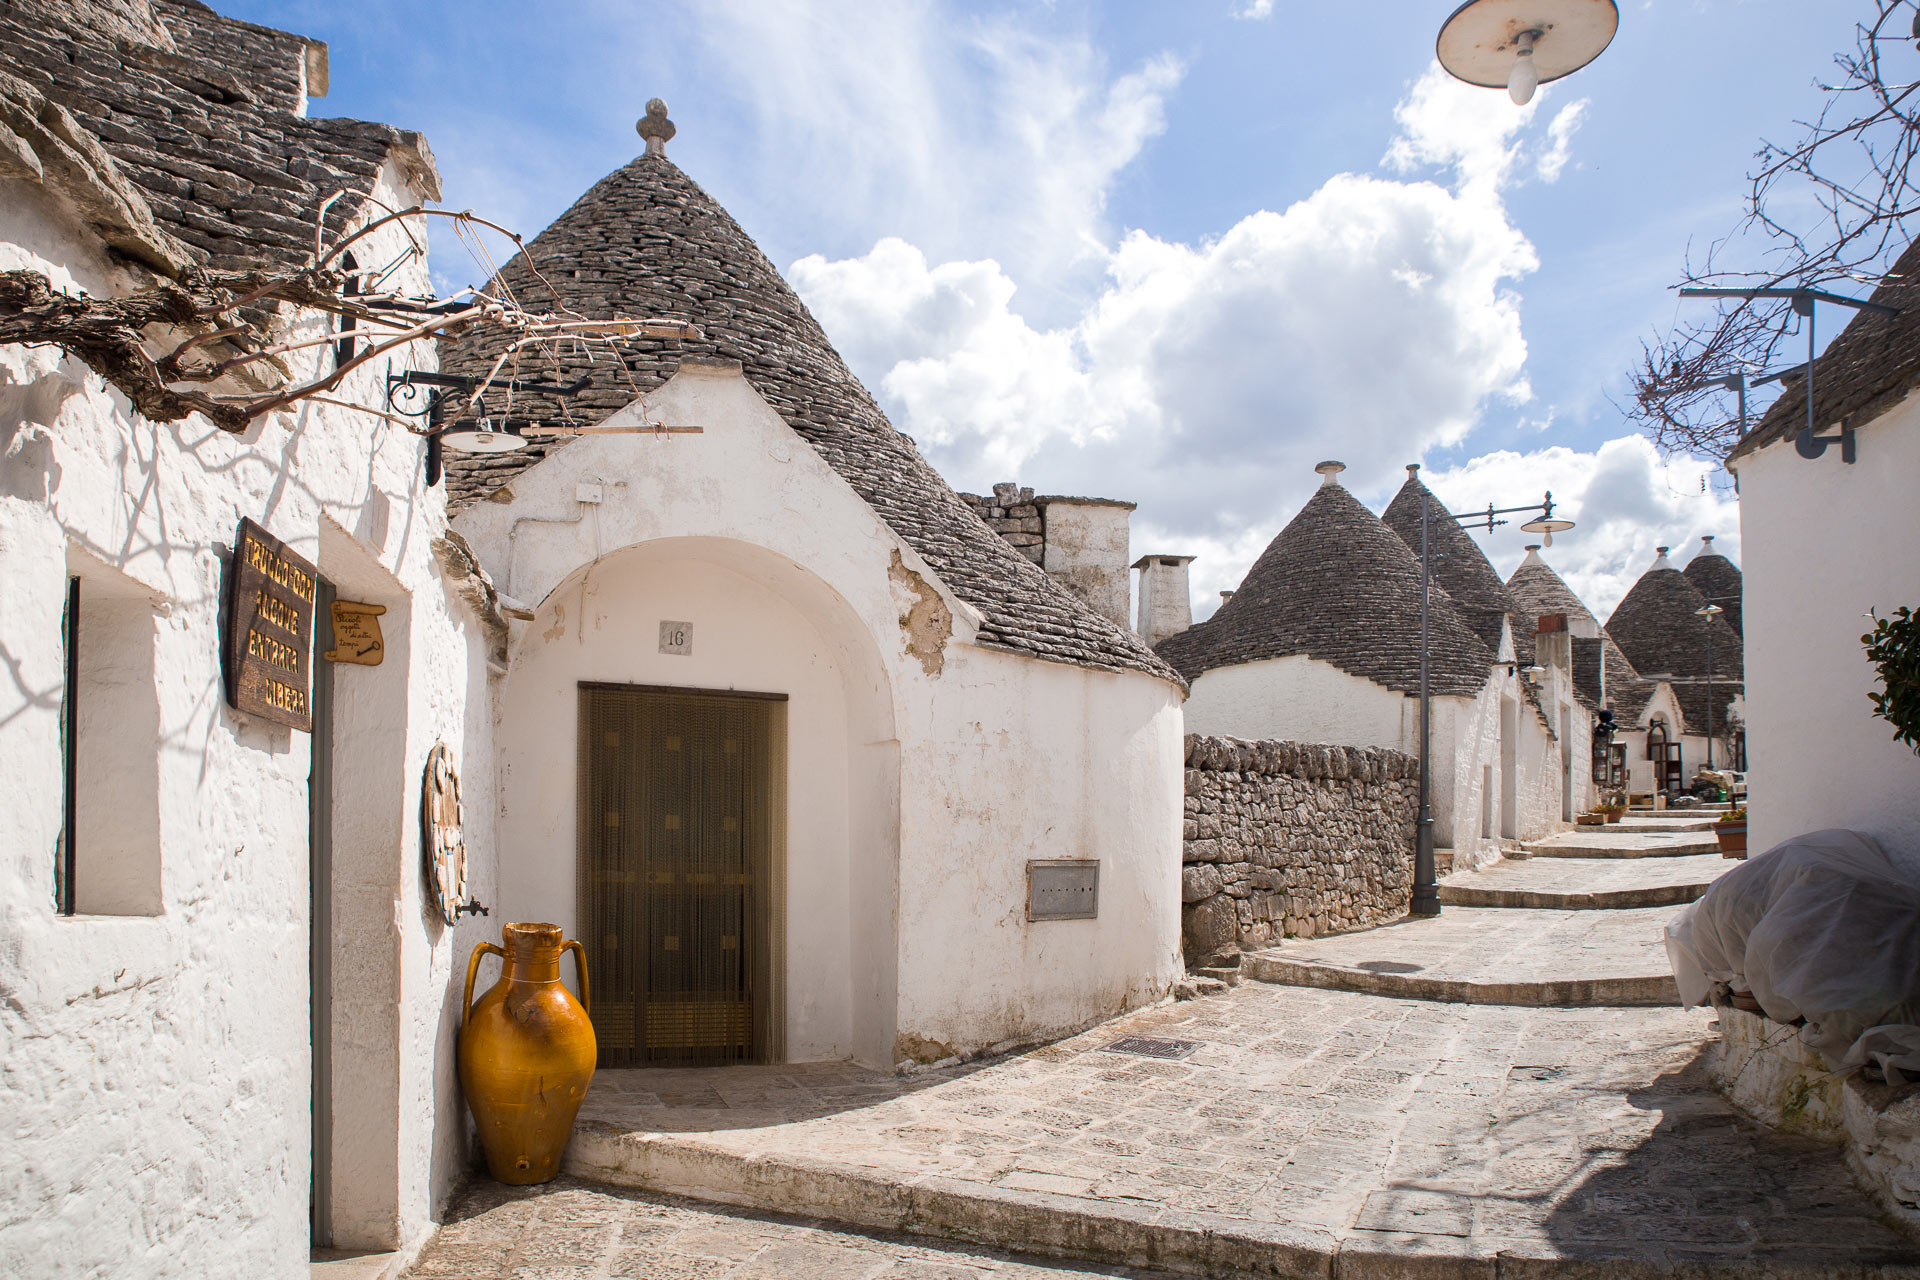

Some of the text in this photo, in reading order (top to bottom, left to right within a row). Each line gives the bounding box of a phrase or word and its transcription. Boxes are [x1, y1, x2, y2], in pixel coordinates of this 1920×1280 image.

[256, 589, 299, 635] ALCOVE
[249, 628, 298, 674] ENTRATA
[338, 638, 359, 650] tempi
[668, 630, 684, 646] 16
[265, 677, 306, 715] LIBERA
